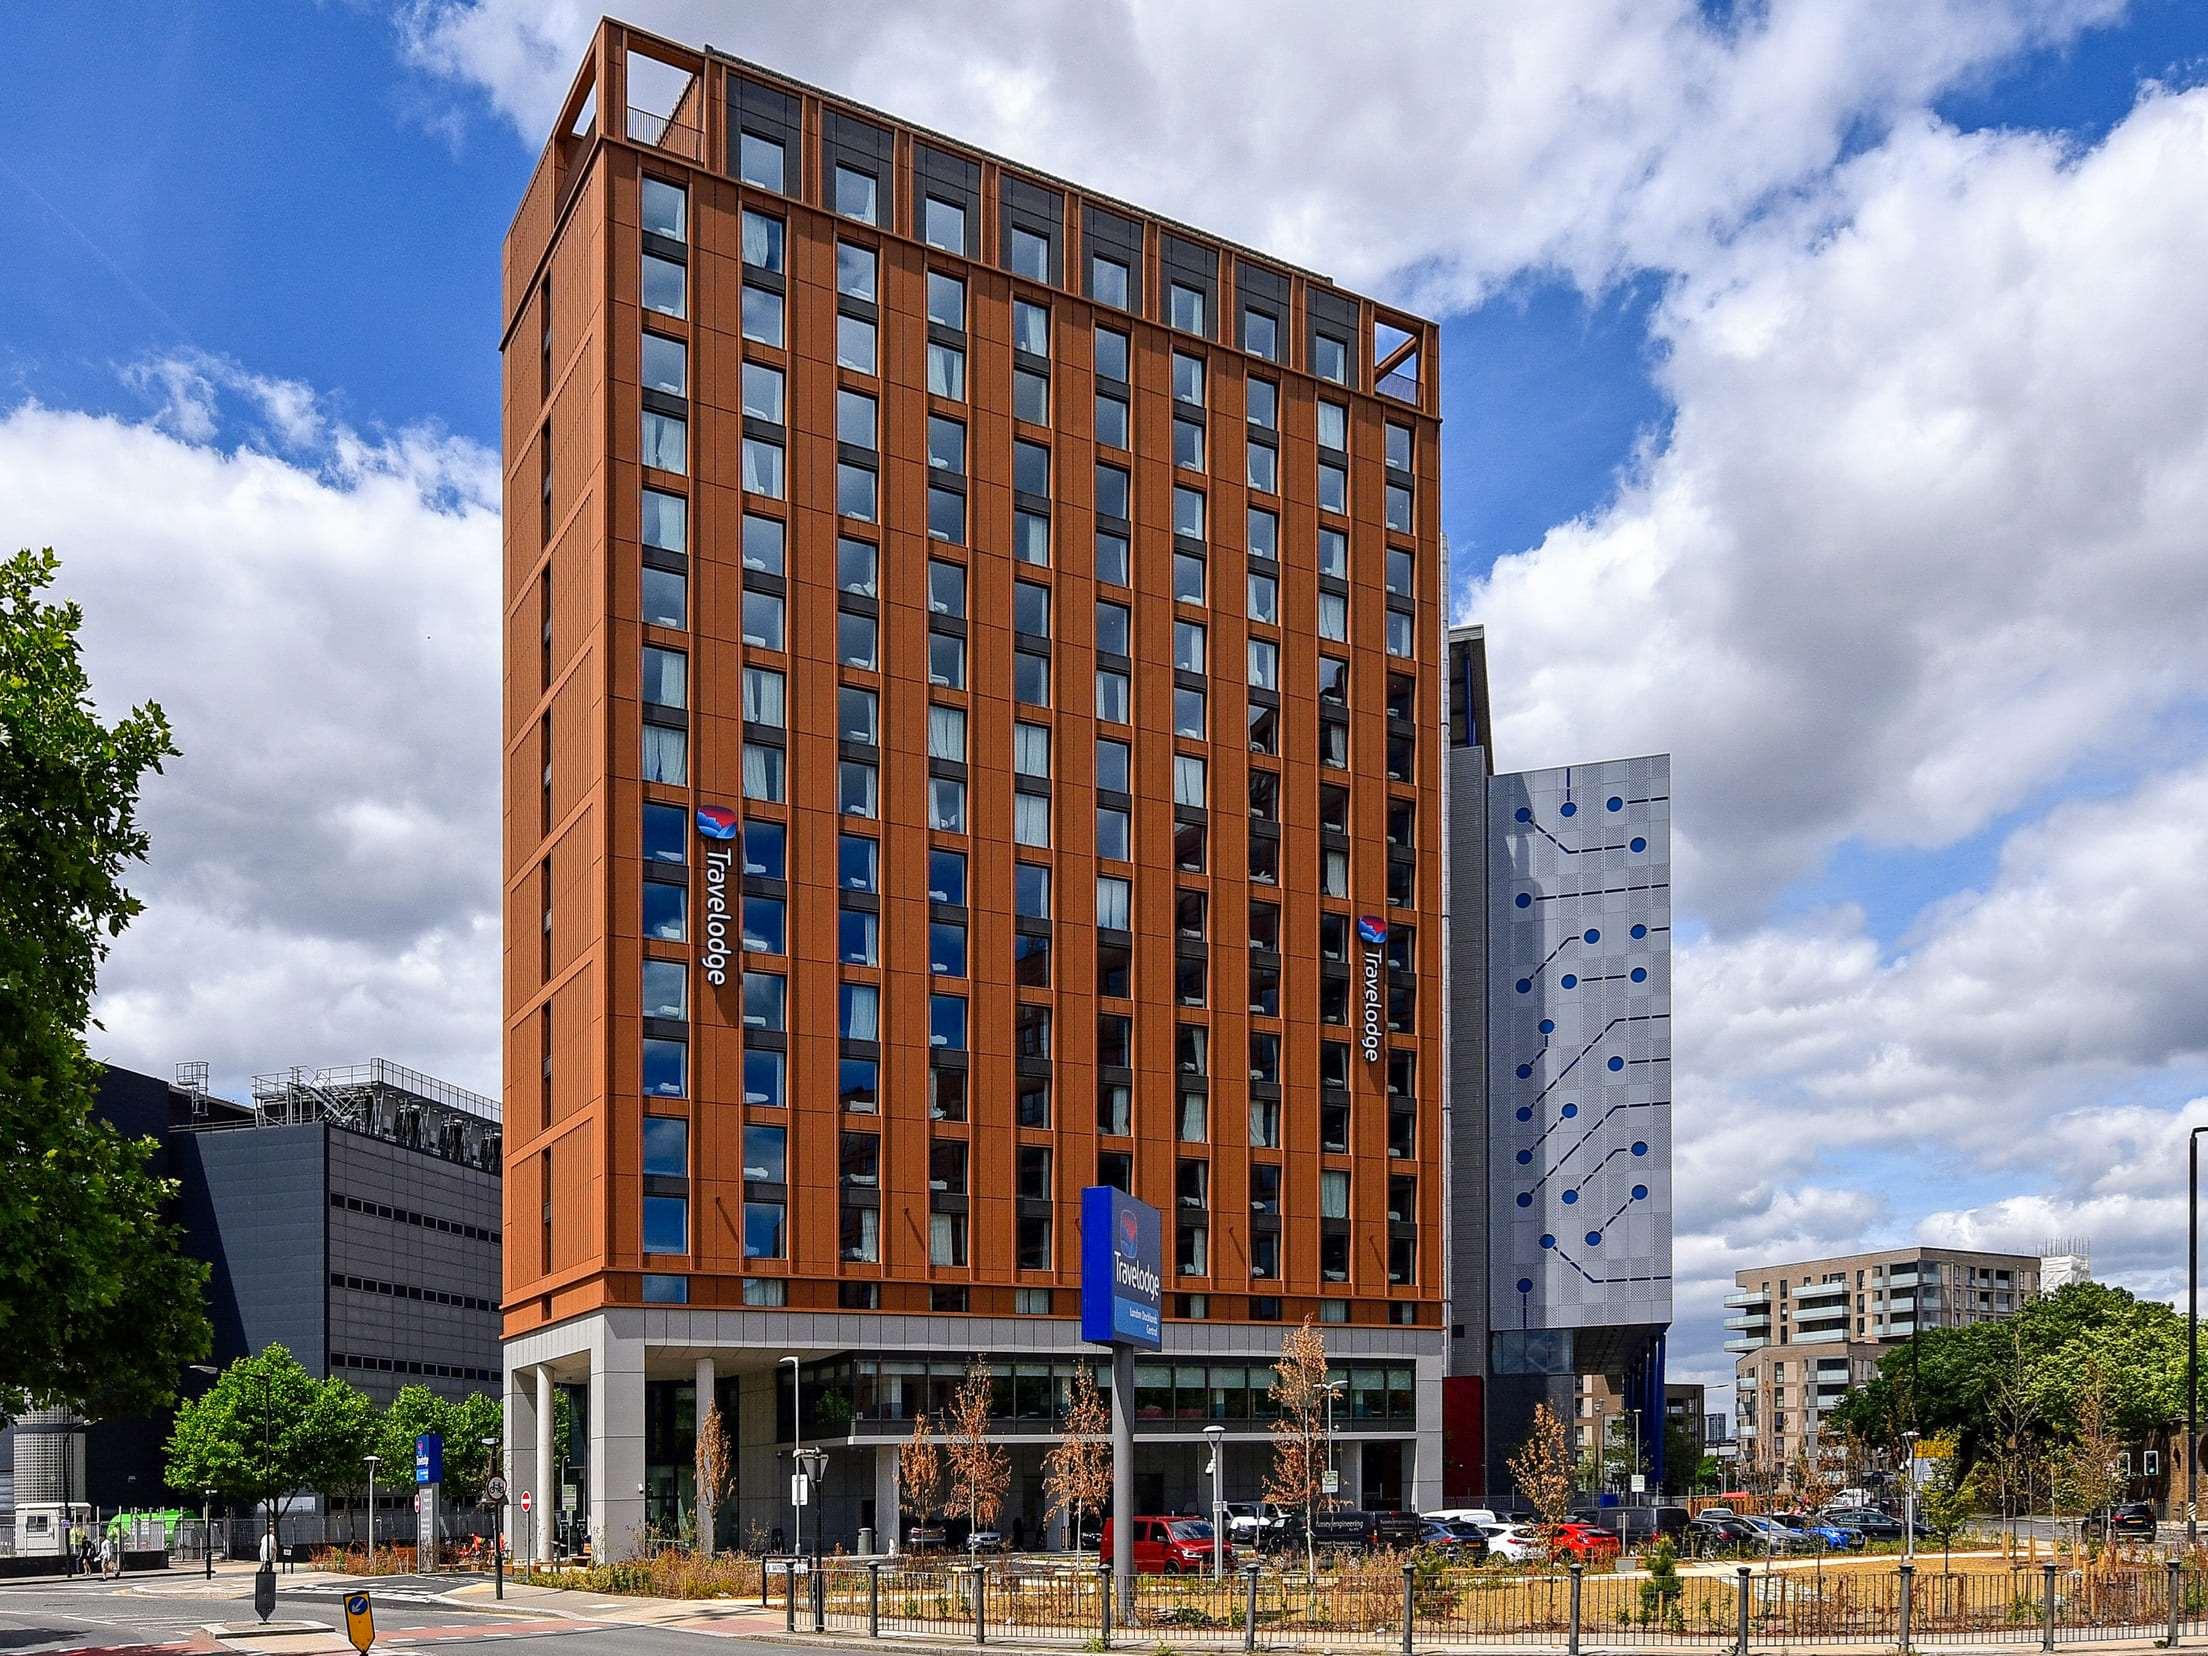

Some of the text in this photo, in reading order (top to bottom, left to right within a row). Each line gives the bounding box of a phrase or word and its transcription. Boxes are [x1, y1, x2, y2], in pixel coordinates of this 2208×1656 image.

[702, 847, 732, 986] Travelodge
[1361, 948, 1383, 1062] Travelodge
[1114, 1250, 1160, 1301] Travelodge
[1130, 1306, 1142, 1319] London
